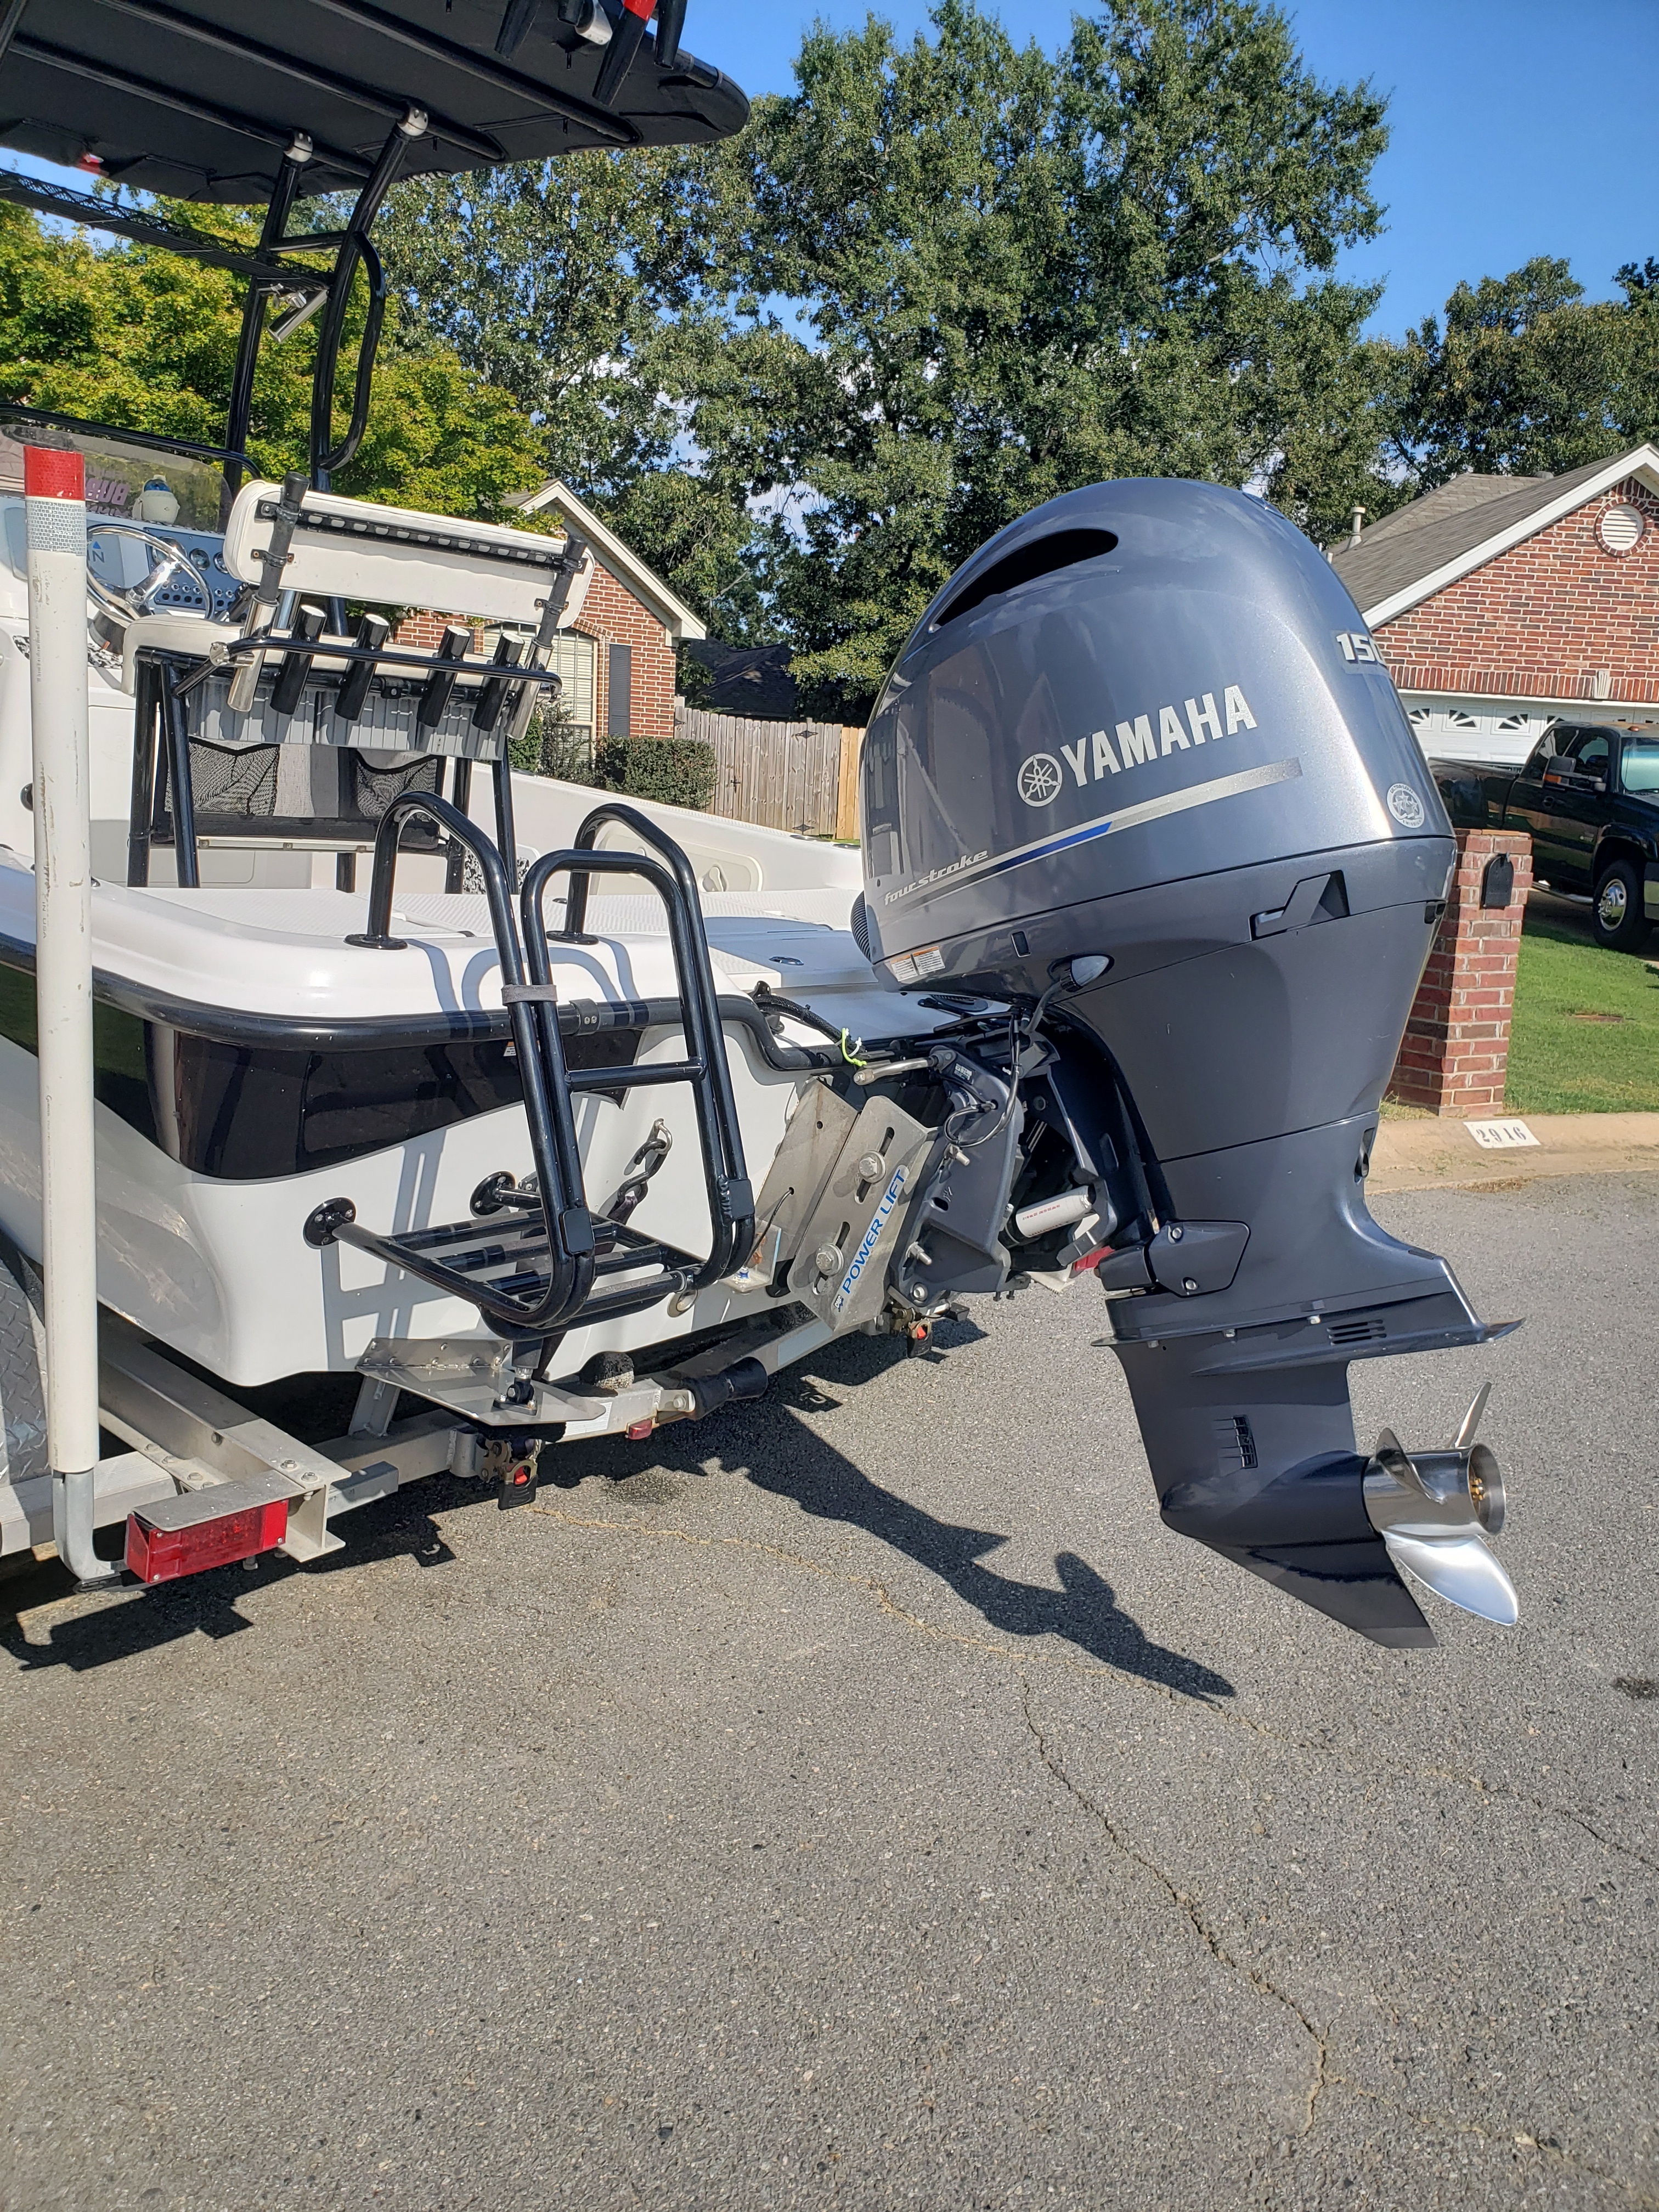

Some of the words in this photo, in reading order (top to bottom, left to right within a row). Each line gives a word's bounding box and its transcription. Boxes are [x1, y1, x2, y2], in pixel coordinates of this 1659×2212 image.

[1060, 685, 1258, 787] YAMAHA
[1476, 1126, 1527, 1143] 2916
[842, 1218, 884, 1294] POWER
[879, 1169, 905, 1216] LIFT
